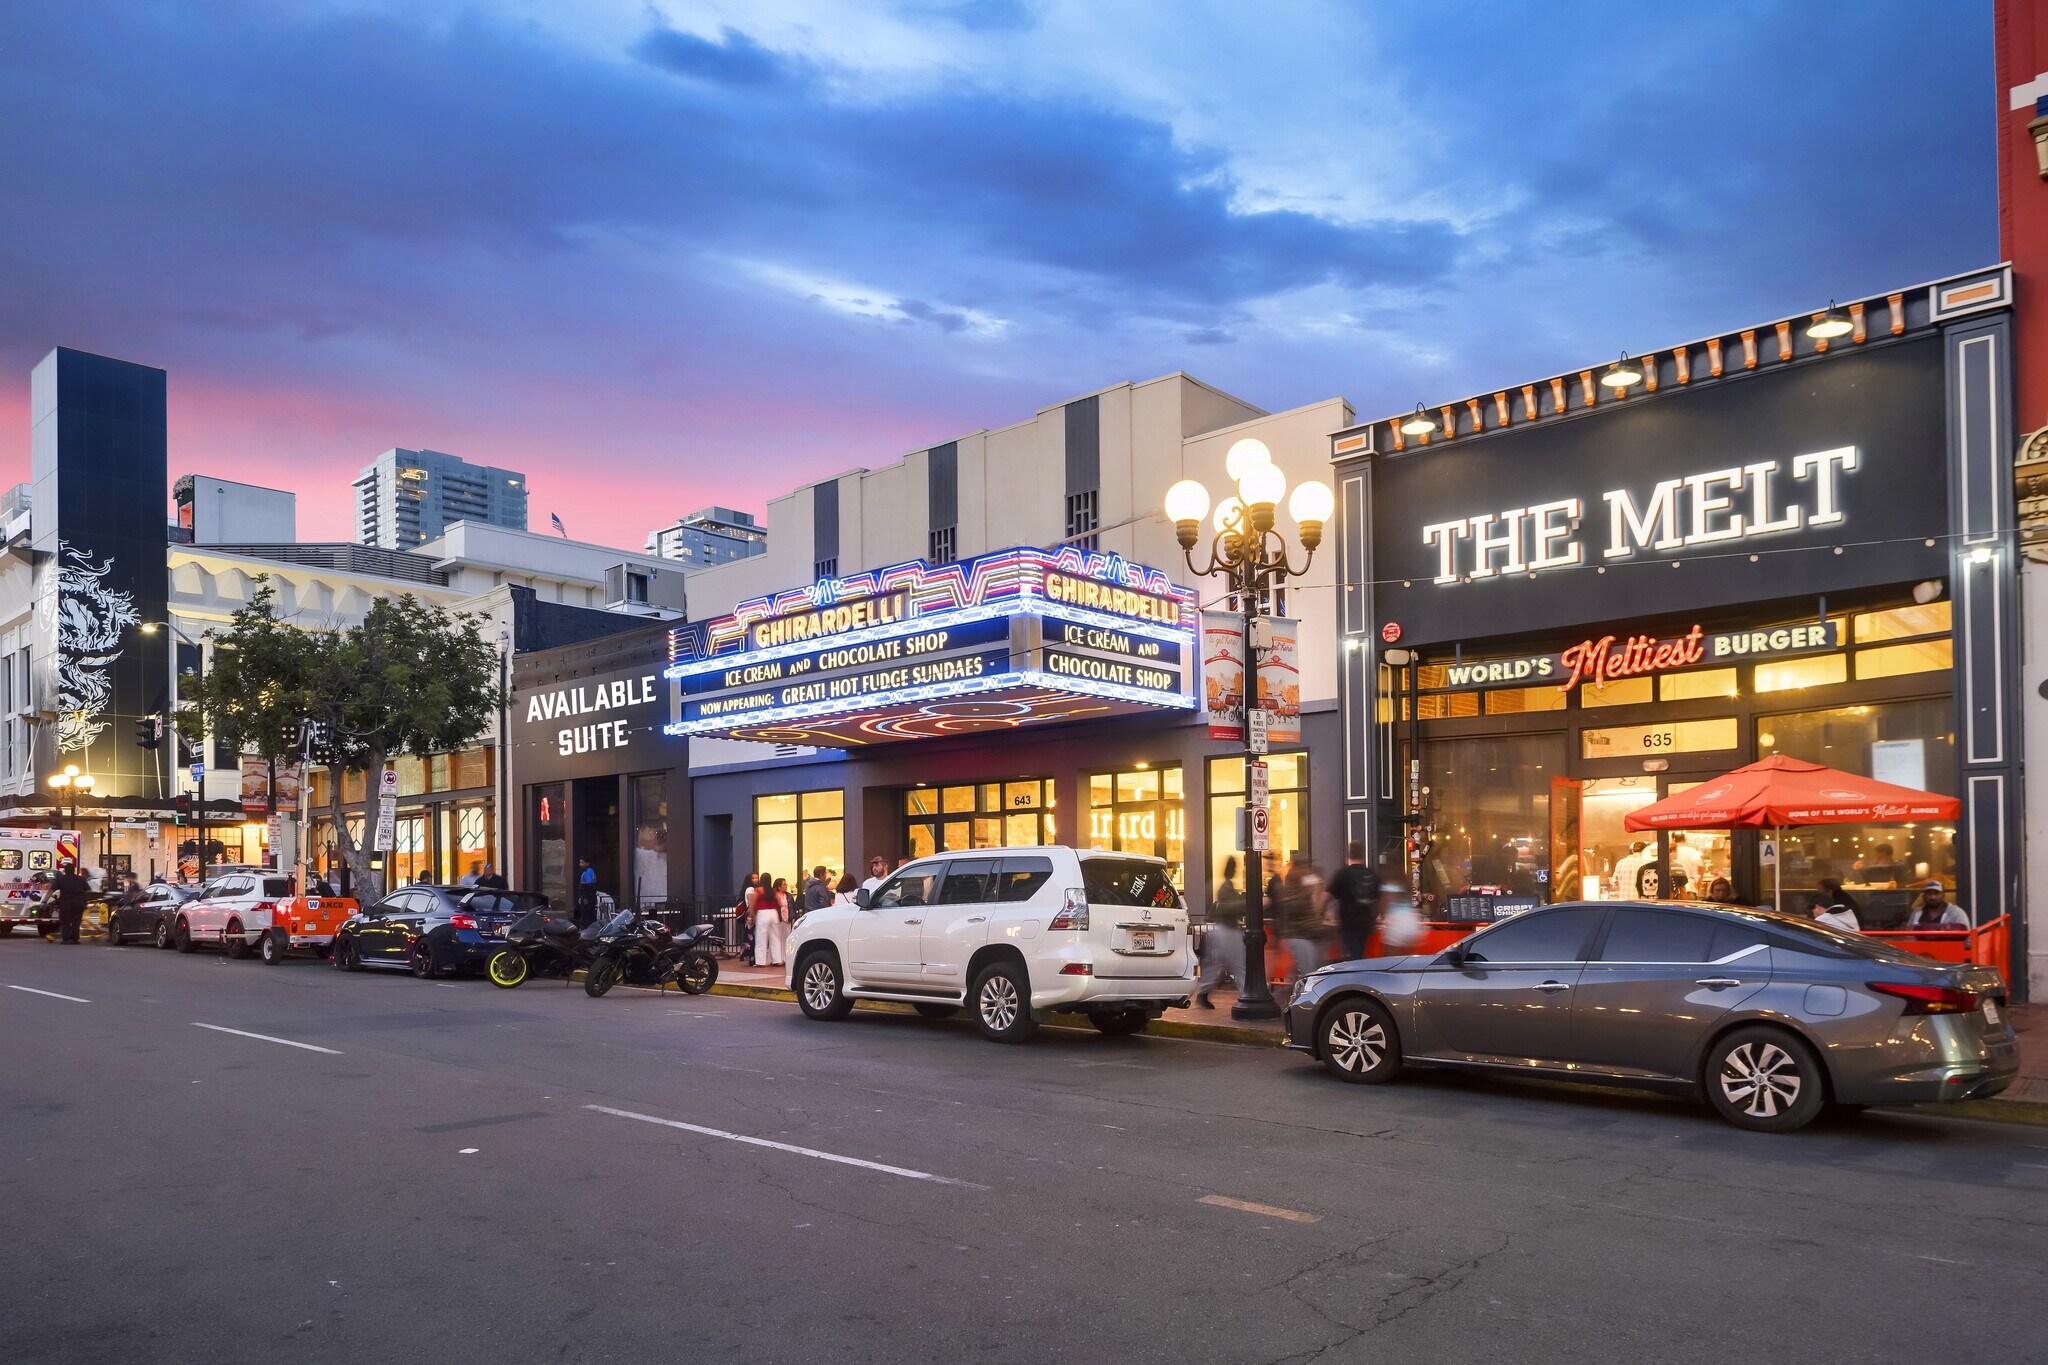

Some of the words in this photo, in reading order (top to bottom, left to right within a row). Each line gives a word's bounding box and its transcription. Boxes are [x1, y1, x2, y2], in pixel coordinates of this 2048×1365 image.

[1423, 498, 1581, 585] THE
[1603, 446, 1857, 558] MELT
[1046, 573, 1180, 625] GHIRARDELLI
[755, 595, 902, 648] GHIRARDELLI
[1064, 624, 1084, 646] ICE
[1087, 629, 1130, 654] CREAM
[1137, 643, 1160, 657] AND
[725, 670, 742, 687] ICE
[743, 662, 782, 683] CREAM
[789, 658, 811, 676] AND
[819, 639, 901, 671] CHOCOLATE
[906, 630, 948, 656] SHOP
[1048, 653, 1133, 685] CHOCOLATE
[1136, 668, 1172, 690] SHOP
[1448, 657, 1553, 686] WORLD'S
[1557, 624, 1704, 693] Meltiest
[1715, 625, 1827, 657] BURGER
[526, 675, 657, 723] AVAILABLE
[701, 703, 723, 716] NOW
[722, 693, 775, 712] APPEARING:
[782, 683, 826, 706] GREAT!
[830, 676, 859, 698] HOT
[862, 669, 909, 694] FUDGE
[912, 655, 983, 687] SUNDAES
[558, 719, 629, 757] SUITE
[1643, 733, 1672, 748] 635
[1014, 795, 1031, 807] 643
[1788, 810, 1809, 818] HOME
[1810, 809, 1820, 817] OF
[1837, 808, 1870, 816] WORLD'S
[1872, 803, 1909, 819] Meltiest
[1763, 844, 1775, 857] A
[308, 900, 344, 910] WANCO
